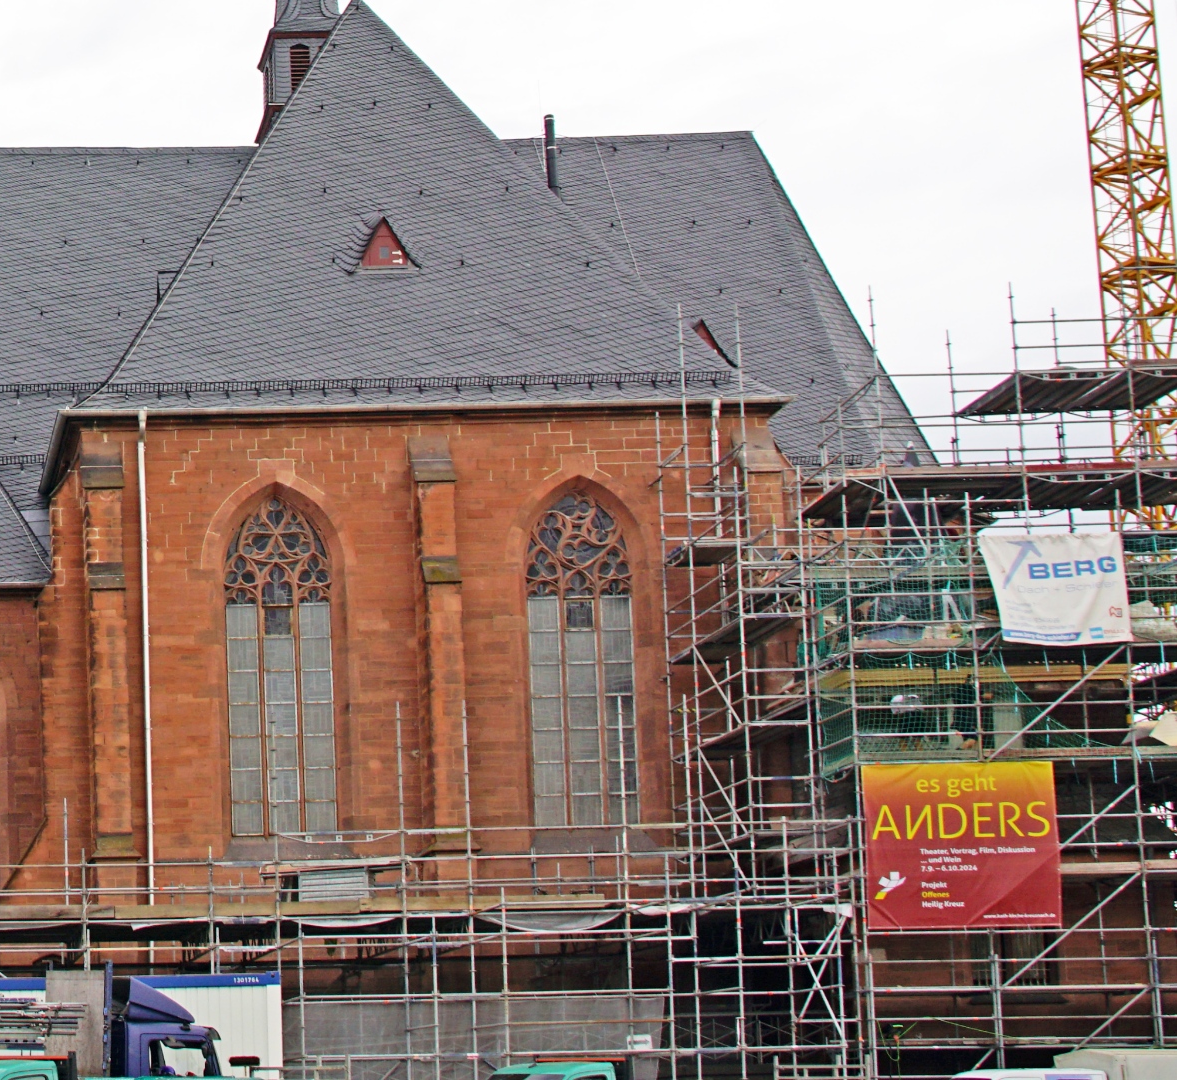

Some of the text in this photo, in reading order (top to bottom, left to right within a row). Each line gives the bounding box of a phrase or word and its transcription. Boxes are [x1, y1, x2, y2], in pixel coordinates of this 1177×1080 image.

[1027, 556, 1117, 579] BERG
[916, 773, 997, 797] es geht
[950, 847, 978, 856] Vortrag,
[997, 846, 1036, 854] Diskussion
[921, 881, 948, 889] Projekt
[921, 900, 944, 909] Heilig
